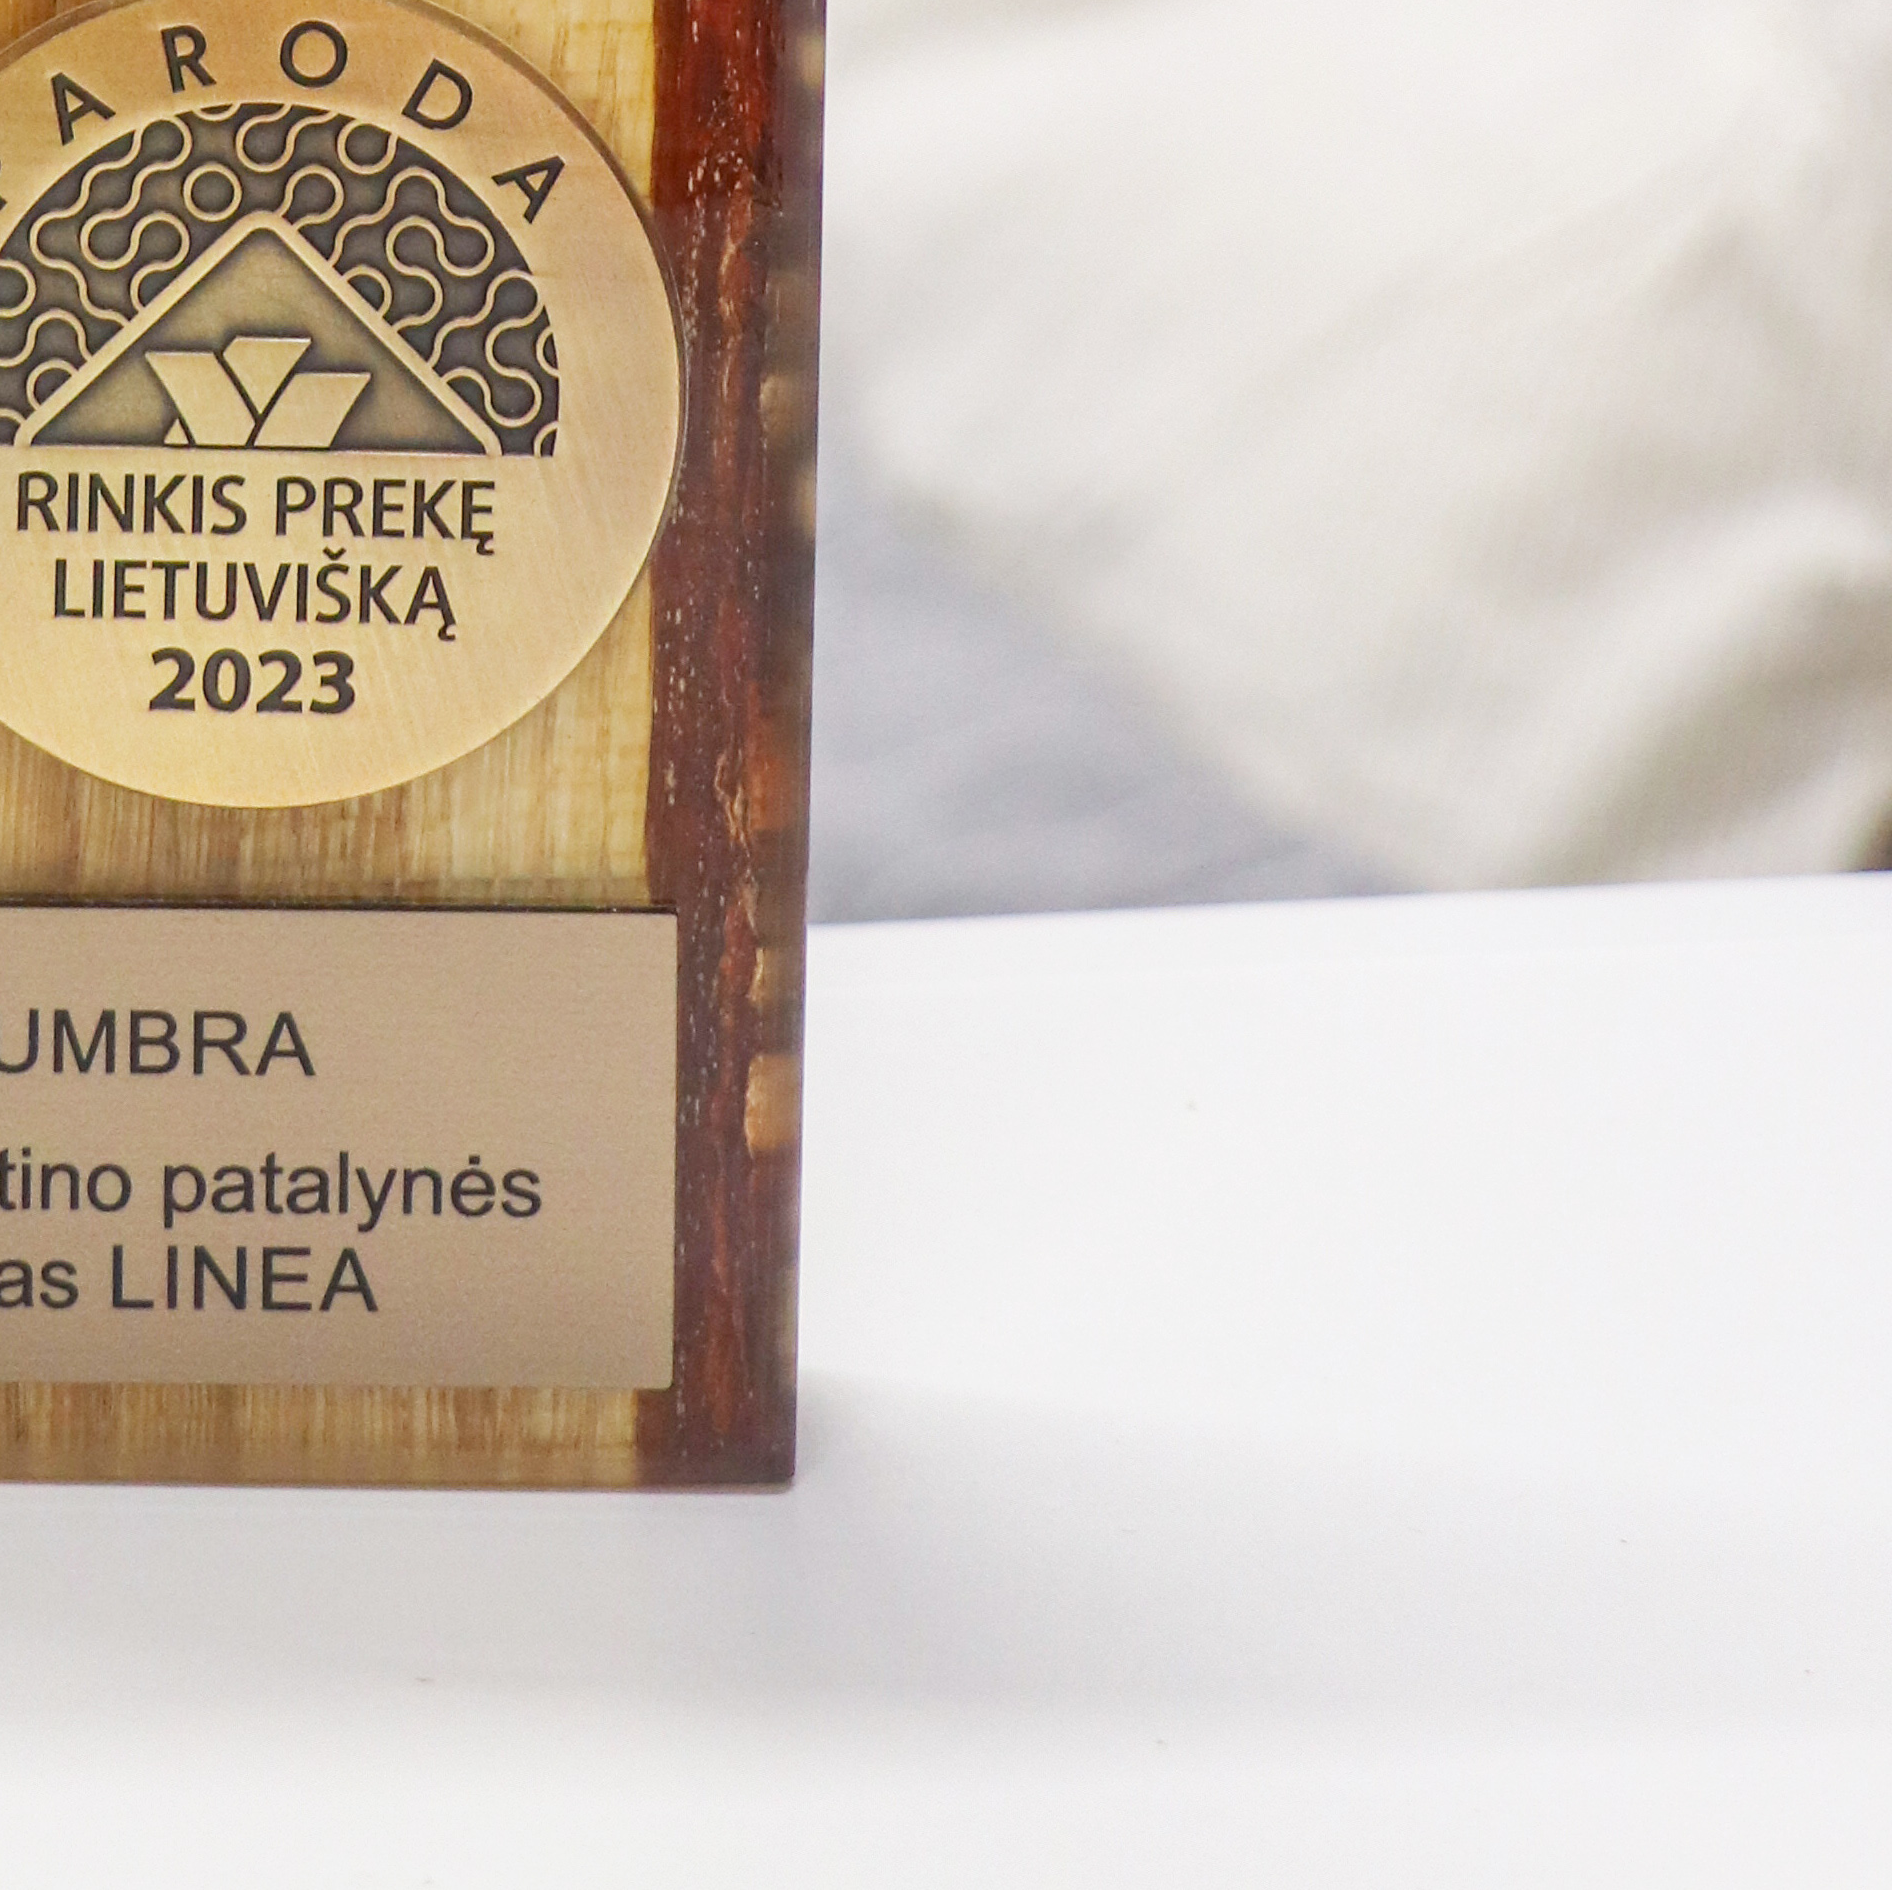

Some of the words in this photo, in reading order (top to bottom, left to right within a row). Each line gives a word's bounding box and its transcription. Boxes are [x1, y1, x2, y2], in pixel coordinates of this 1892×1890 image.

[16, 470, 247, 536] RINKIS
[275, 476, 496, 556] PREKĘ
[53, 547, 457, 642] LIETUVIŠKĄ
[148, 647, 356, 715] 2023
[162, 1150, 542, 1232] patalynės
[111, 1245, 379, 1313] LINEA
